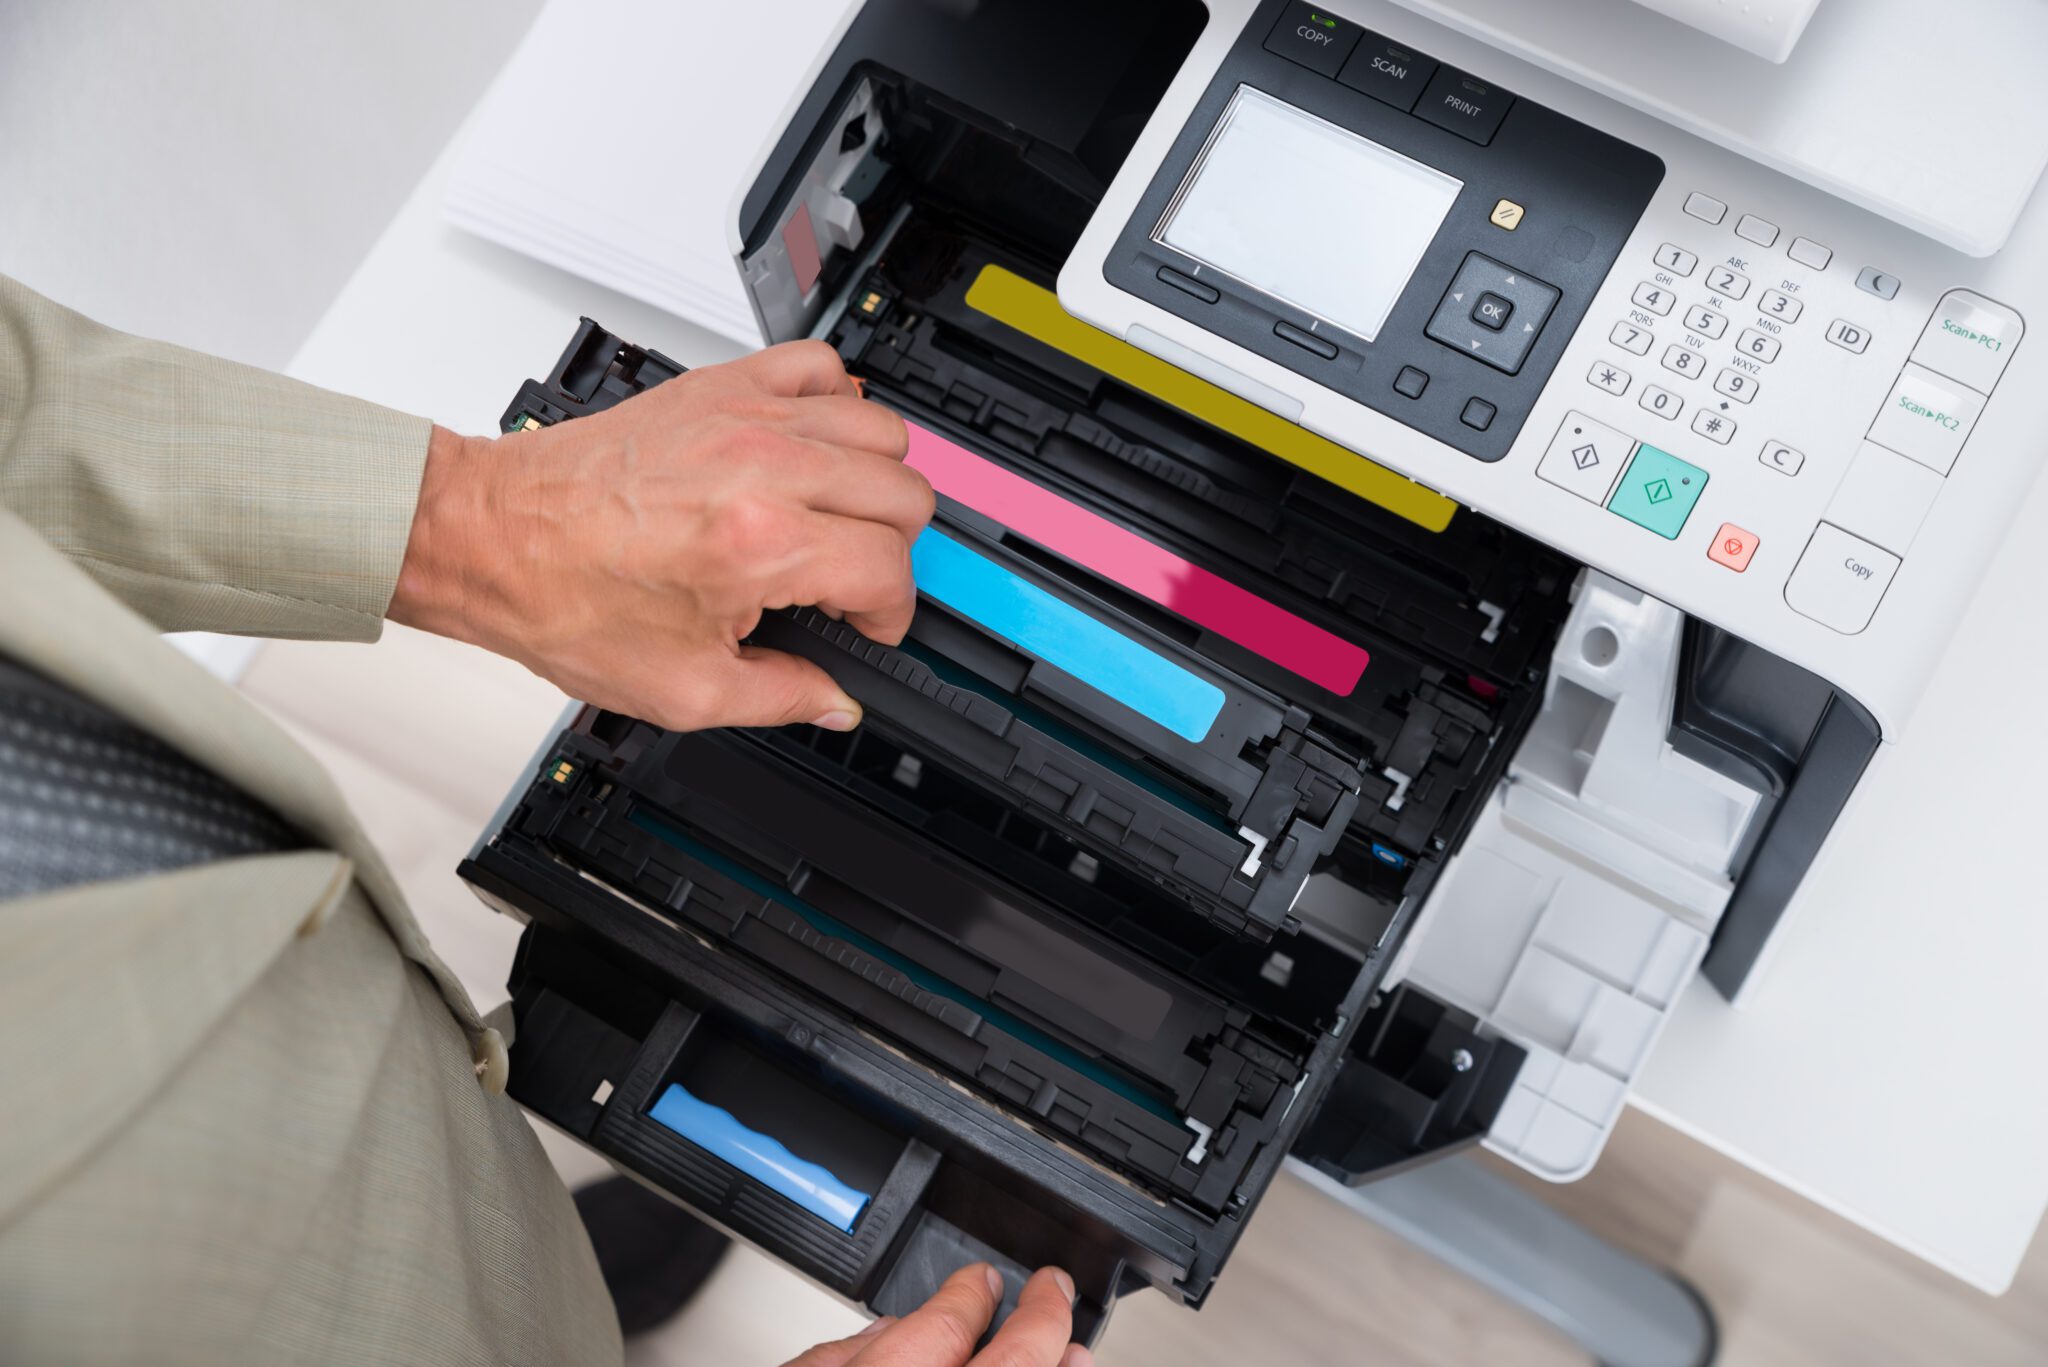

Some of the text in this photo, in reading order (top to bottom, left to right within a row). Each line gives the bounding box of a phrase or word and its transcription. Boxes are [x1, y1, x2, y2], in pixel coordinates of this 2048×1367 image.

[1296, 25, 1333, 47] COPY
[1370, 56, 1407, 80] SCAN
[1444, 95, 1482, 117] PRINT
[1670, 251, 1682, 266] 1
[1726, 256, 1749, 272] ABC
[1654, 272, 1674, 287] GHI
[1719, 273, 1734, 290] 2
[1780, 279, 1801, 294] DEF
[1645, 290, 1661, 306] 4
[1707, 295, 1724, 310] JKL
[1772, 296, 1788, 313] 3
[1481, 303, 1503, 320] OK
[1628, 309, 1655, 328] PQRS
[1697, 313, 1714, 330] 5
[1756, 317, 1782, 335] MNO
[1624, 329, 1639, 345] 7
[1684, 334, 1706, 349] TUV
[1836, 325, 1861, 345] ID
[1751, 337, 1767, 353] 6
[1676, 352, 1692, 369] 8
[1731, 355, 1762, 376] WXYZ
[1728, 376, 1744, 393] 9
[1654, 393, 1668, 410] 0
[1705, 417, 1722, 433] #
[1773, 449, 1790, 466] C
[1844, 557, 1875, 580] Copy
